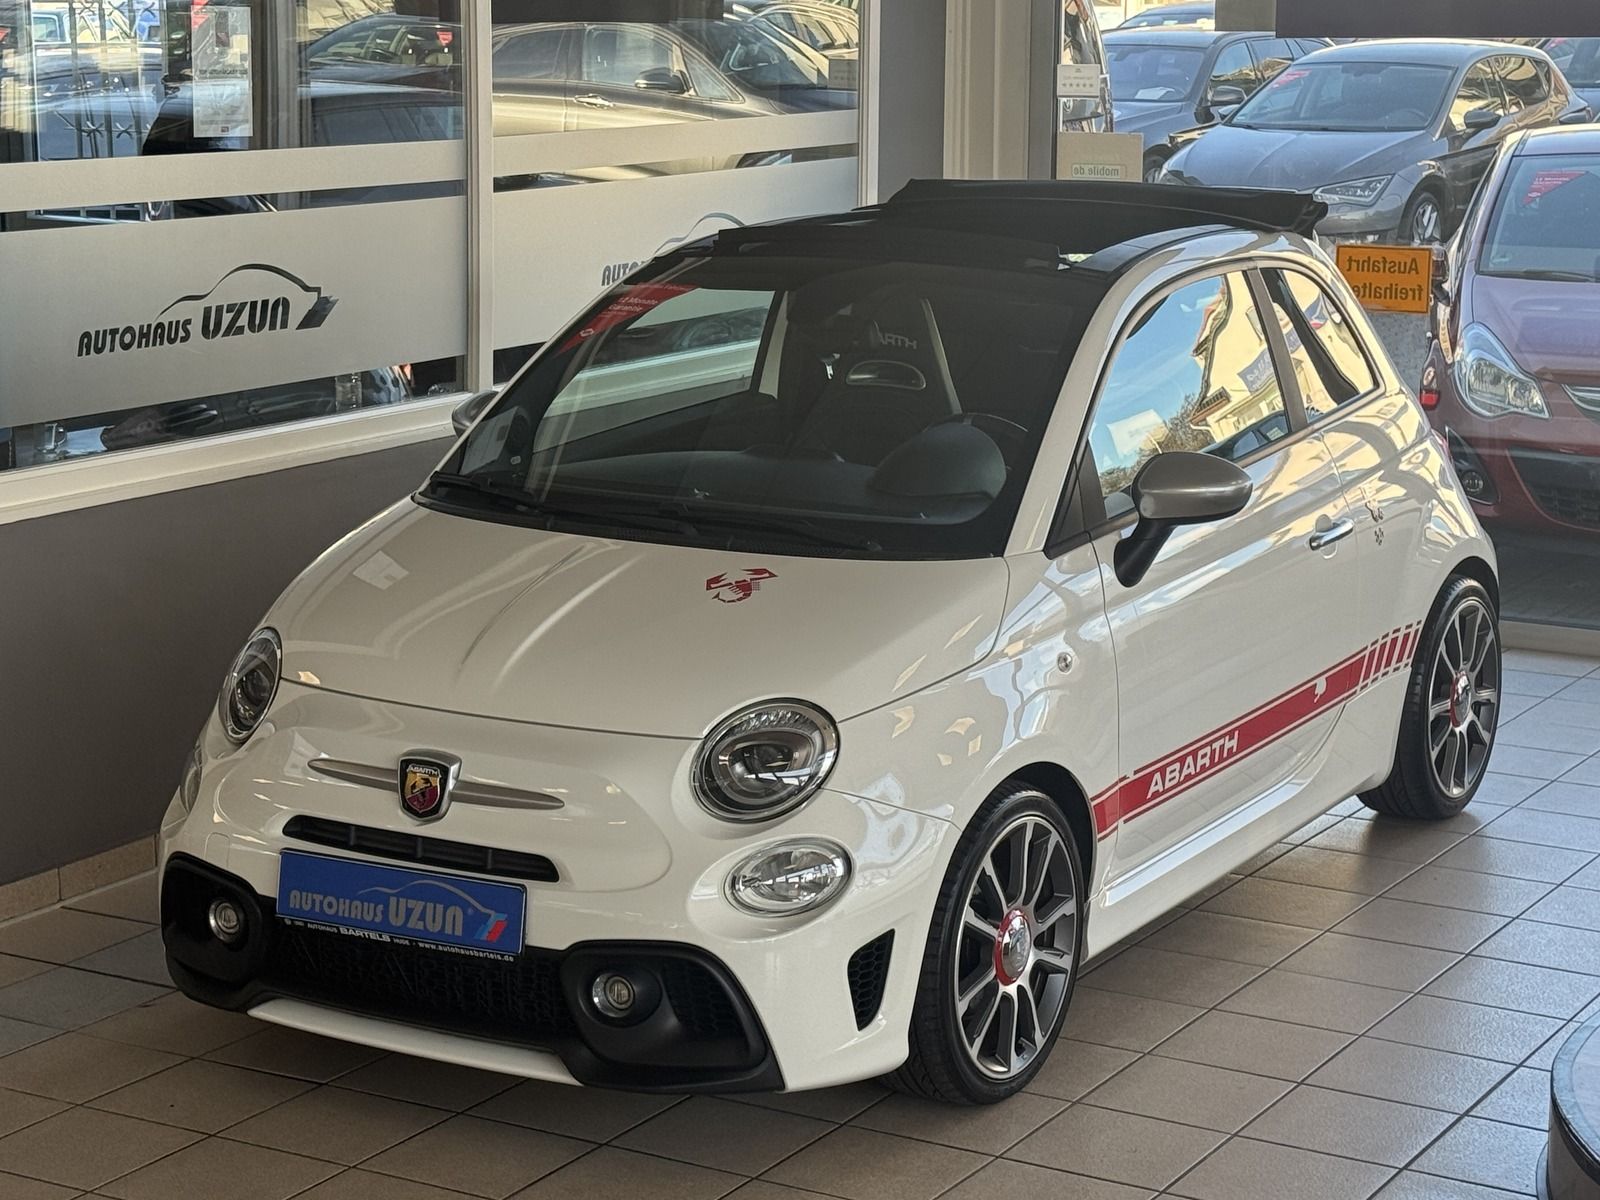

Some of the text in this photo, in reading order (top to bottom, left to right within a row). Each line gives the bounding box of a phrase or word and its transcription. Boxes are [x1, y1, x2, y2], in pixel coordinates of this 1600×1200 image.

[77, 296, 291, 358] AUTOHAUS UZUN
[1146, 729, 1239, 800] ABARTH
[289, 889, 464, 937] AUTOHAUS UZUN
[339, 927, 392, 943] BARTELS
